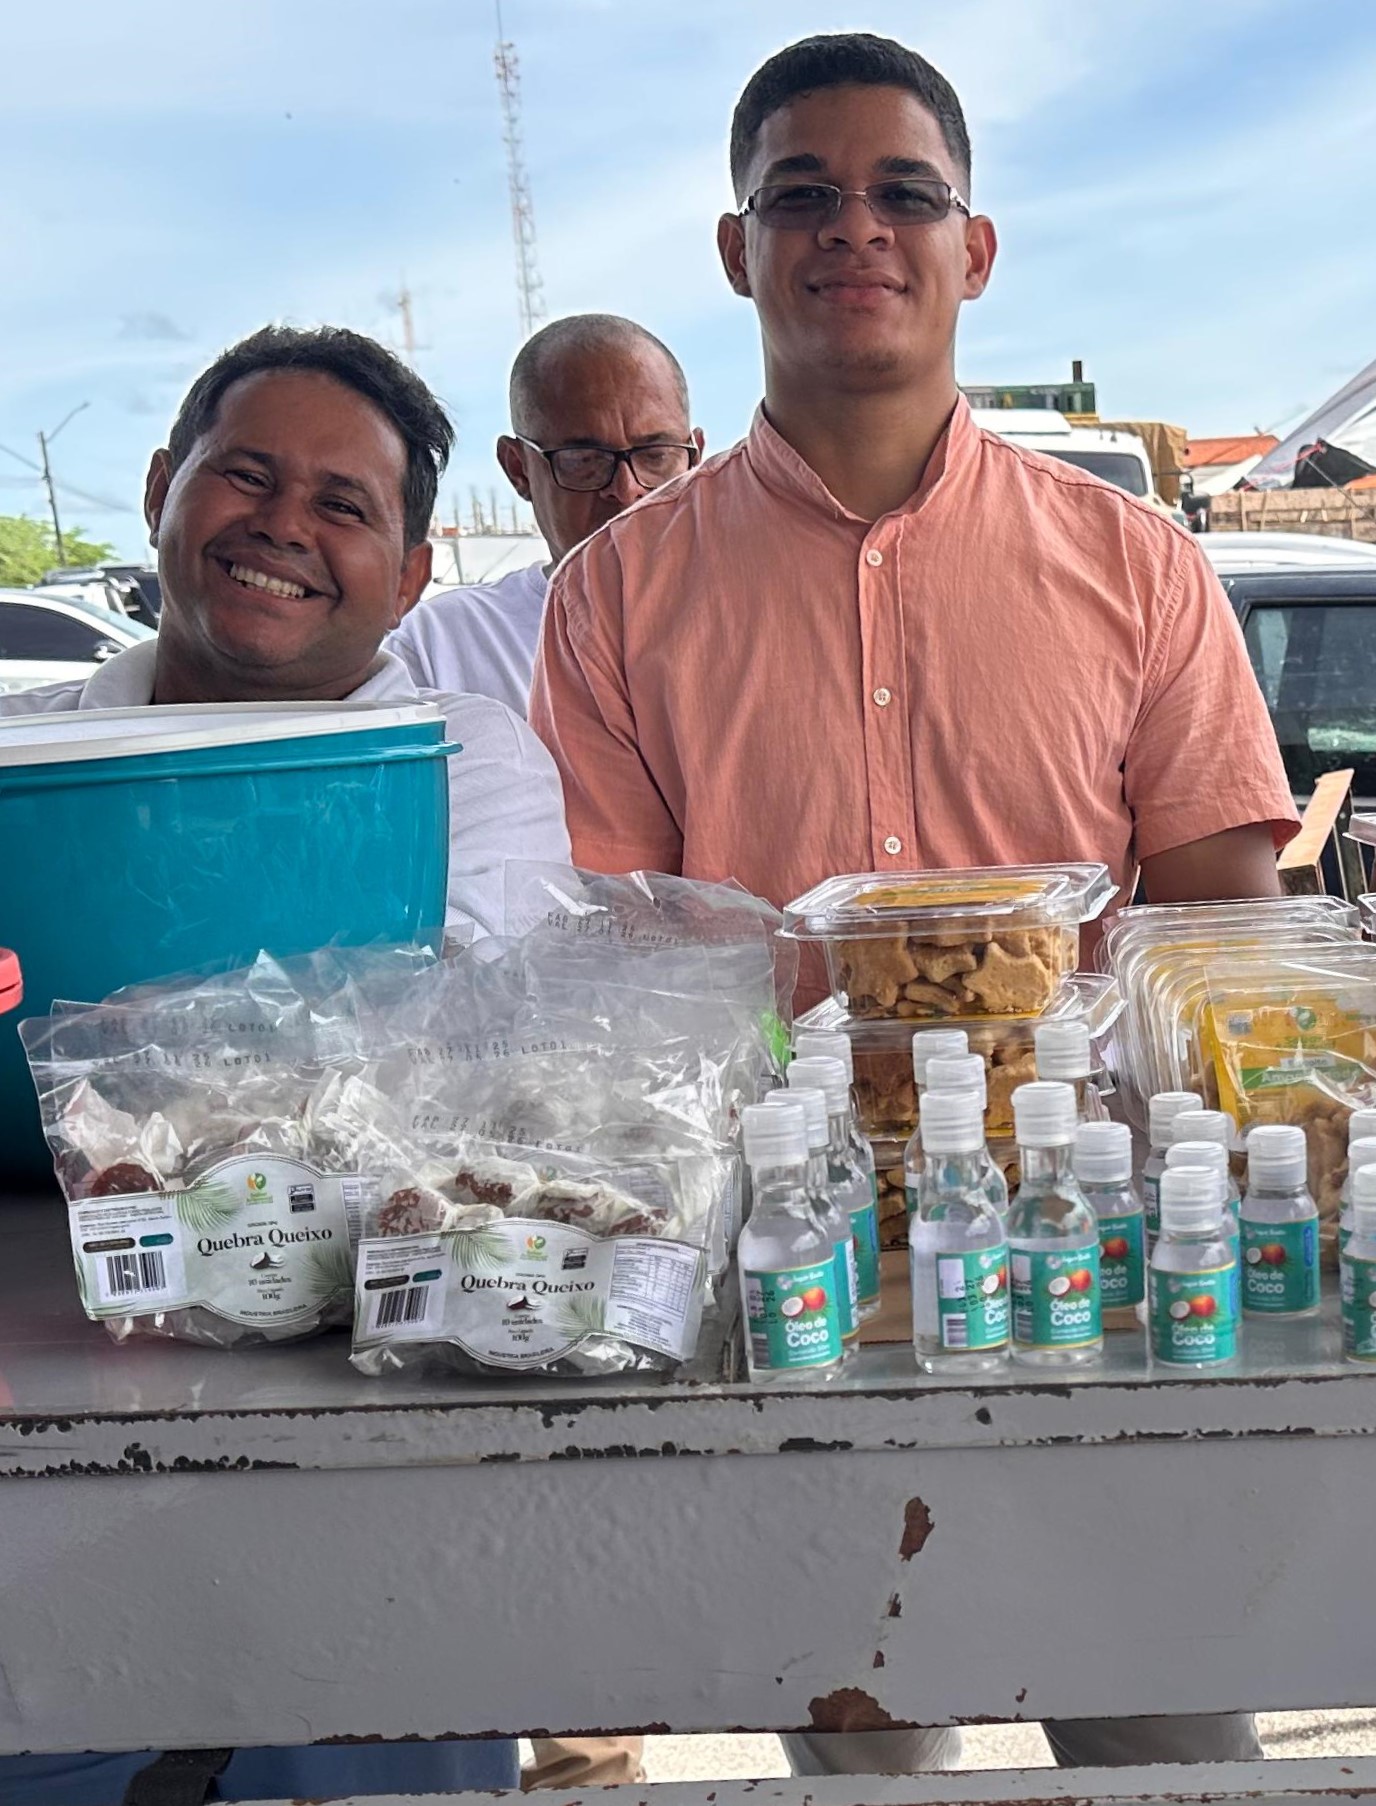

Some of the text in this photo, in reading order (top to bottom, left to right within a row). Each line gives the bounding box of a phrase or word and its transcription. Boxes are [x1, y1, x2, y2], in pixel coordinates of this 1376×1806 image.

[521, 1040, 567, 1055] LOT01
[197, 1226, 333, 1257] Quebra Queixo
[1114, 1264, 1128, 1275] de
[1269, 1270, 1285, 1281] de
[460, 1274, 595, 1296] Quebra Queixo
[1101, 1277, 1128, 1290] oco
[1247, 1278, 1285, 1294] Coco
[1050, 1297, 1092, 1312] Óleo de
[784, 1316, 828, 1333] Óleo de
[1050, 1310, 1092, 1327] Coco
[786, 1329, 829, 1348] Coco
[1171, 1331, 1216, 1347] Coco
